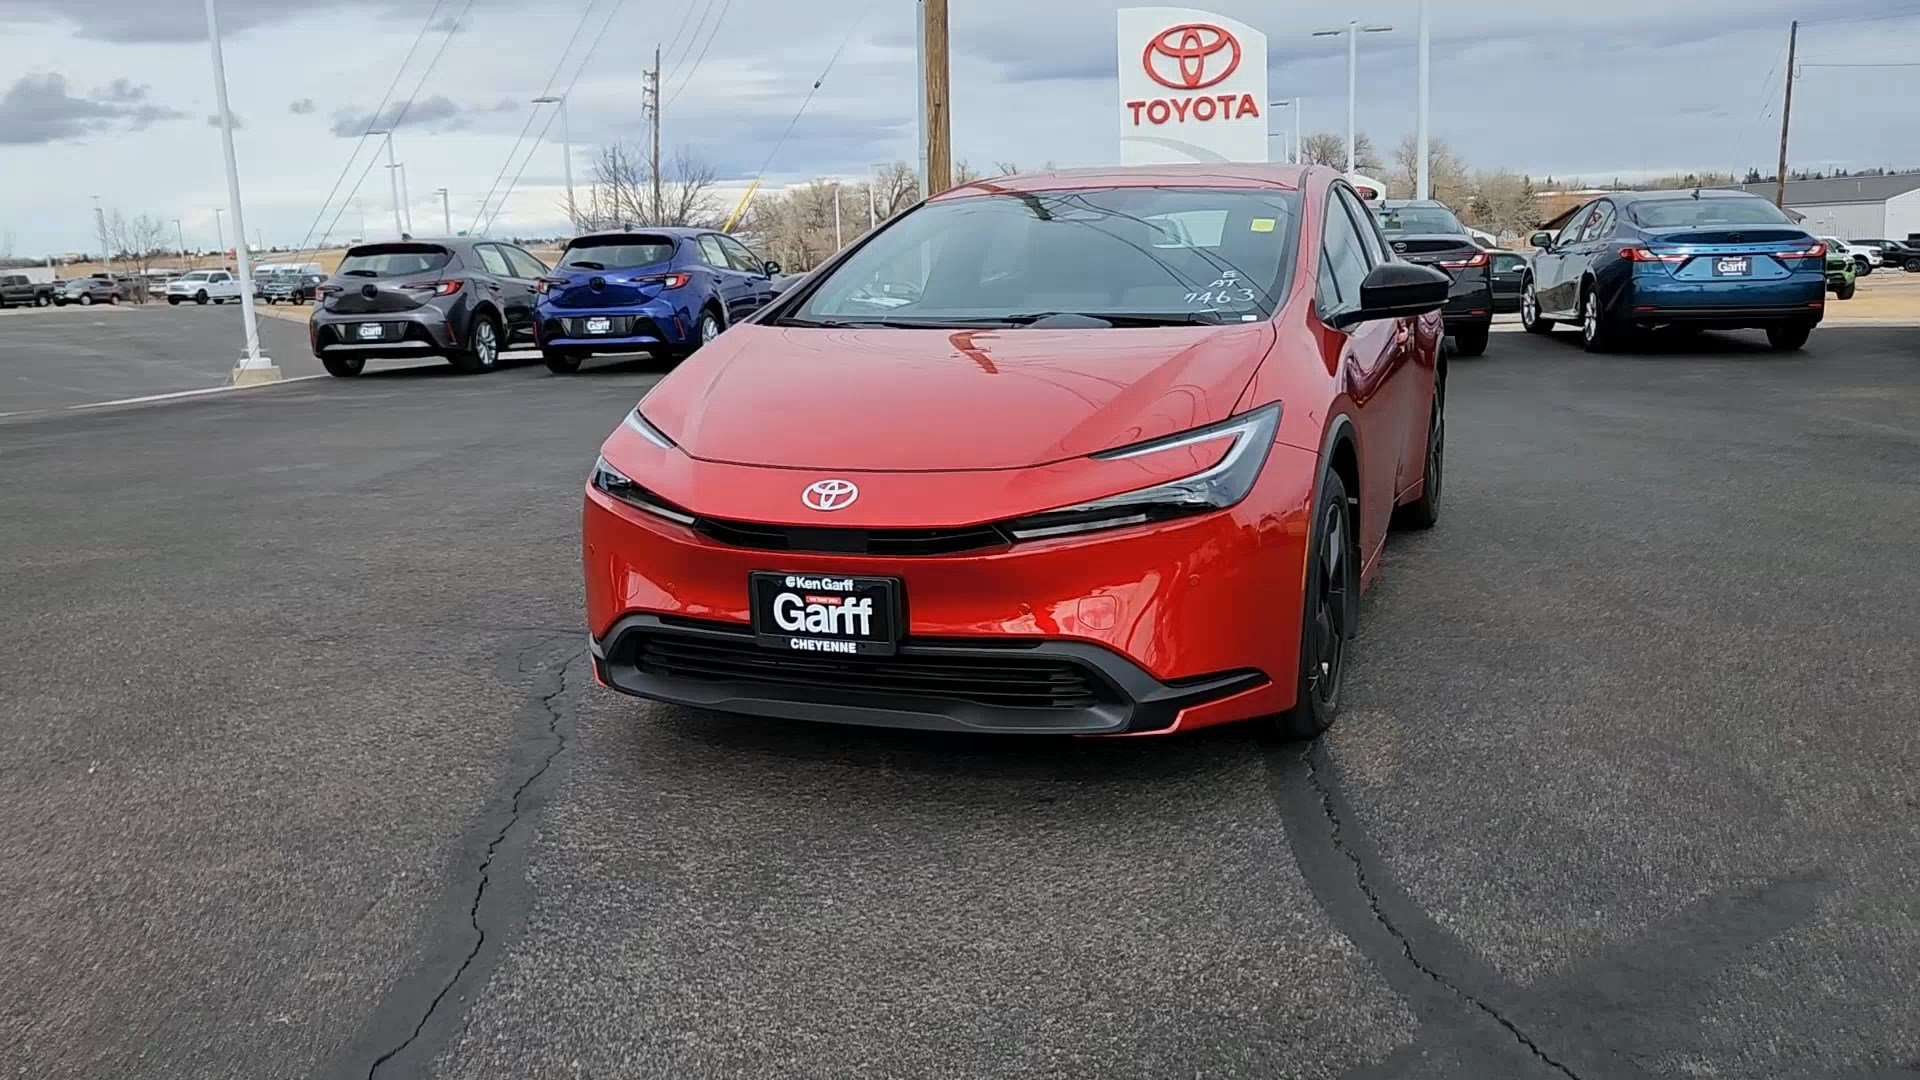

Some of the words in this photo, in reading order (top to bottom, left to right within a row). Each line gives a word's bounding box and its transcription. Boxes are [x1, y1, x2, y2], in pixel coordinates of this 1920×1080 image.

[1127, 94, 1259, 126] TOYOTA
[1717, 261, 1747, 272] Garff
[1183, 288, 1255, 304] 7463
[796, 576, 821, 590] Ken
[821, 578, 854, 592] Garff
[773, 592, 873, 635] Garff
[790, 638, 857, 654] CHEYENNE
